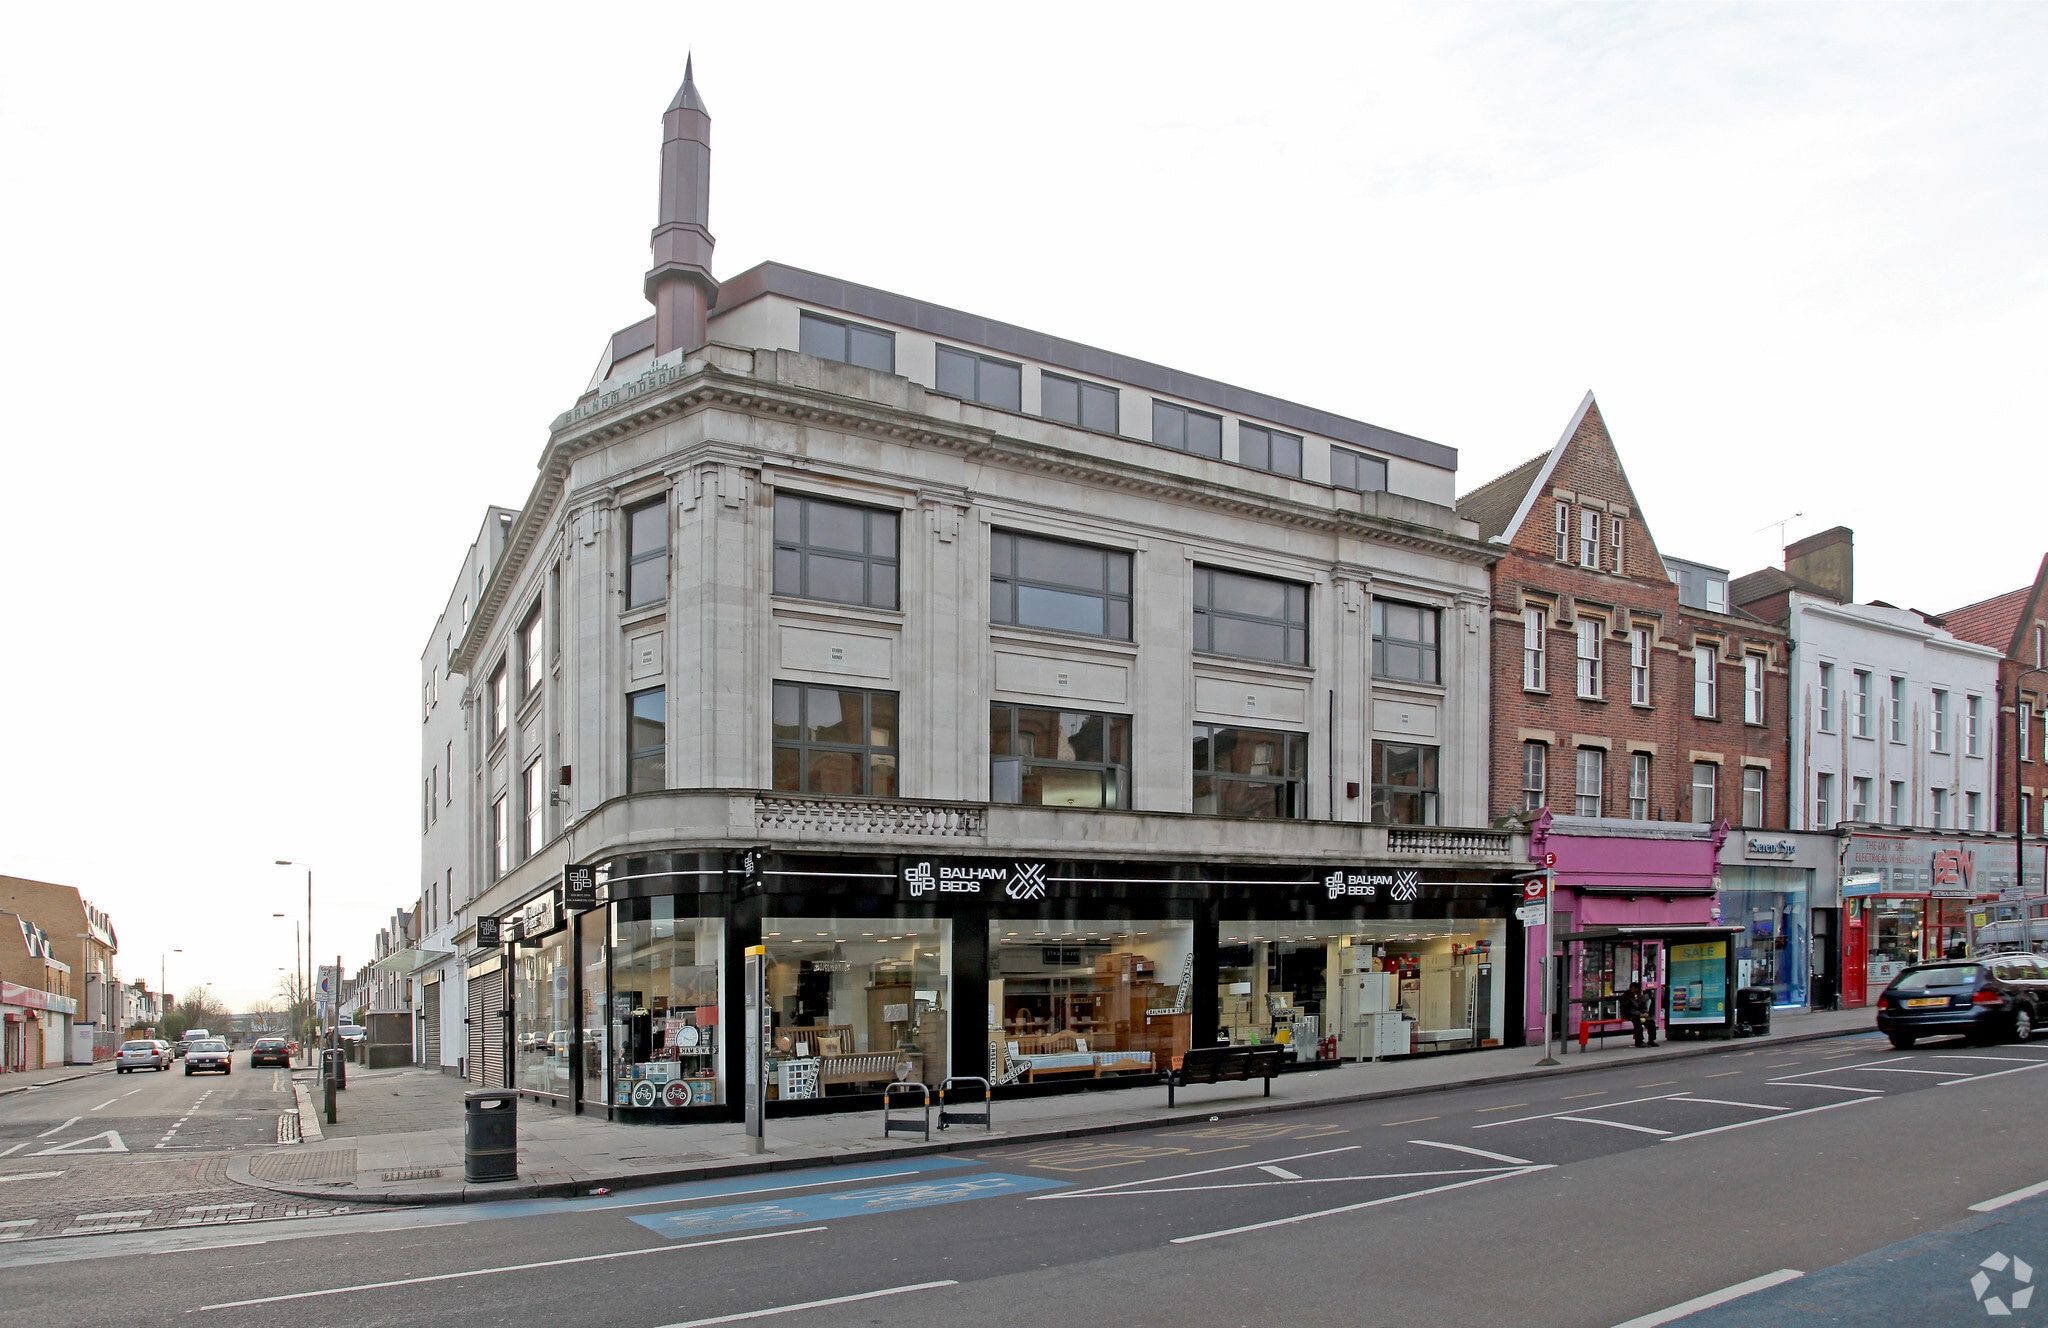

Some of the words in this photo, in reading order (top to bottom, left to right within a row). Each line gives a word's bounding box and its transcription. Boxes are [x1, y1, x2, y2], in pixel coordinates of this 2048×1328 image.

[565, 391, 620, 424] BALHAM
[627, 364, 688, 398] MOSQUE
[1866, 840, 1877, 851] THE
[1546, 854, 1553, 864] E
[1855, 852, 1888, 863] ELECTRICAL
[939, 867, 1007, 880] BALHAM
[1347, 875, 1393, 885] BALHAM
[939, 880, 981, 893] BEDS
[1347, 886, 1376, 896] BEDS
[1682, 945, 1715, 958] SALE
[1000, 1067, 1023, 1085] CHELSEA
